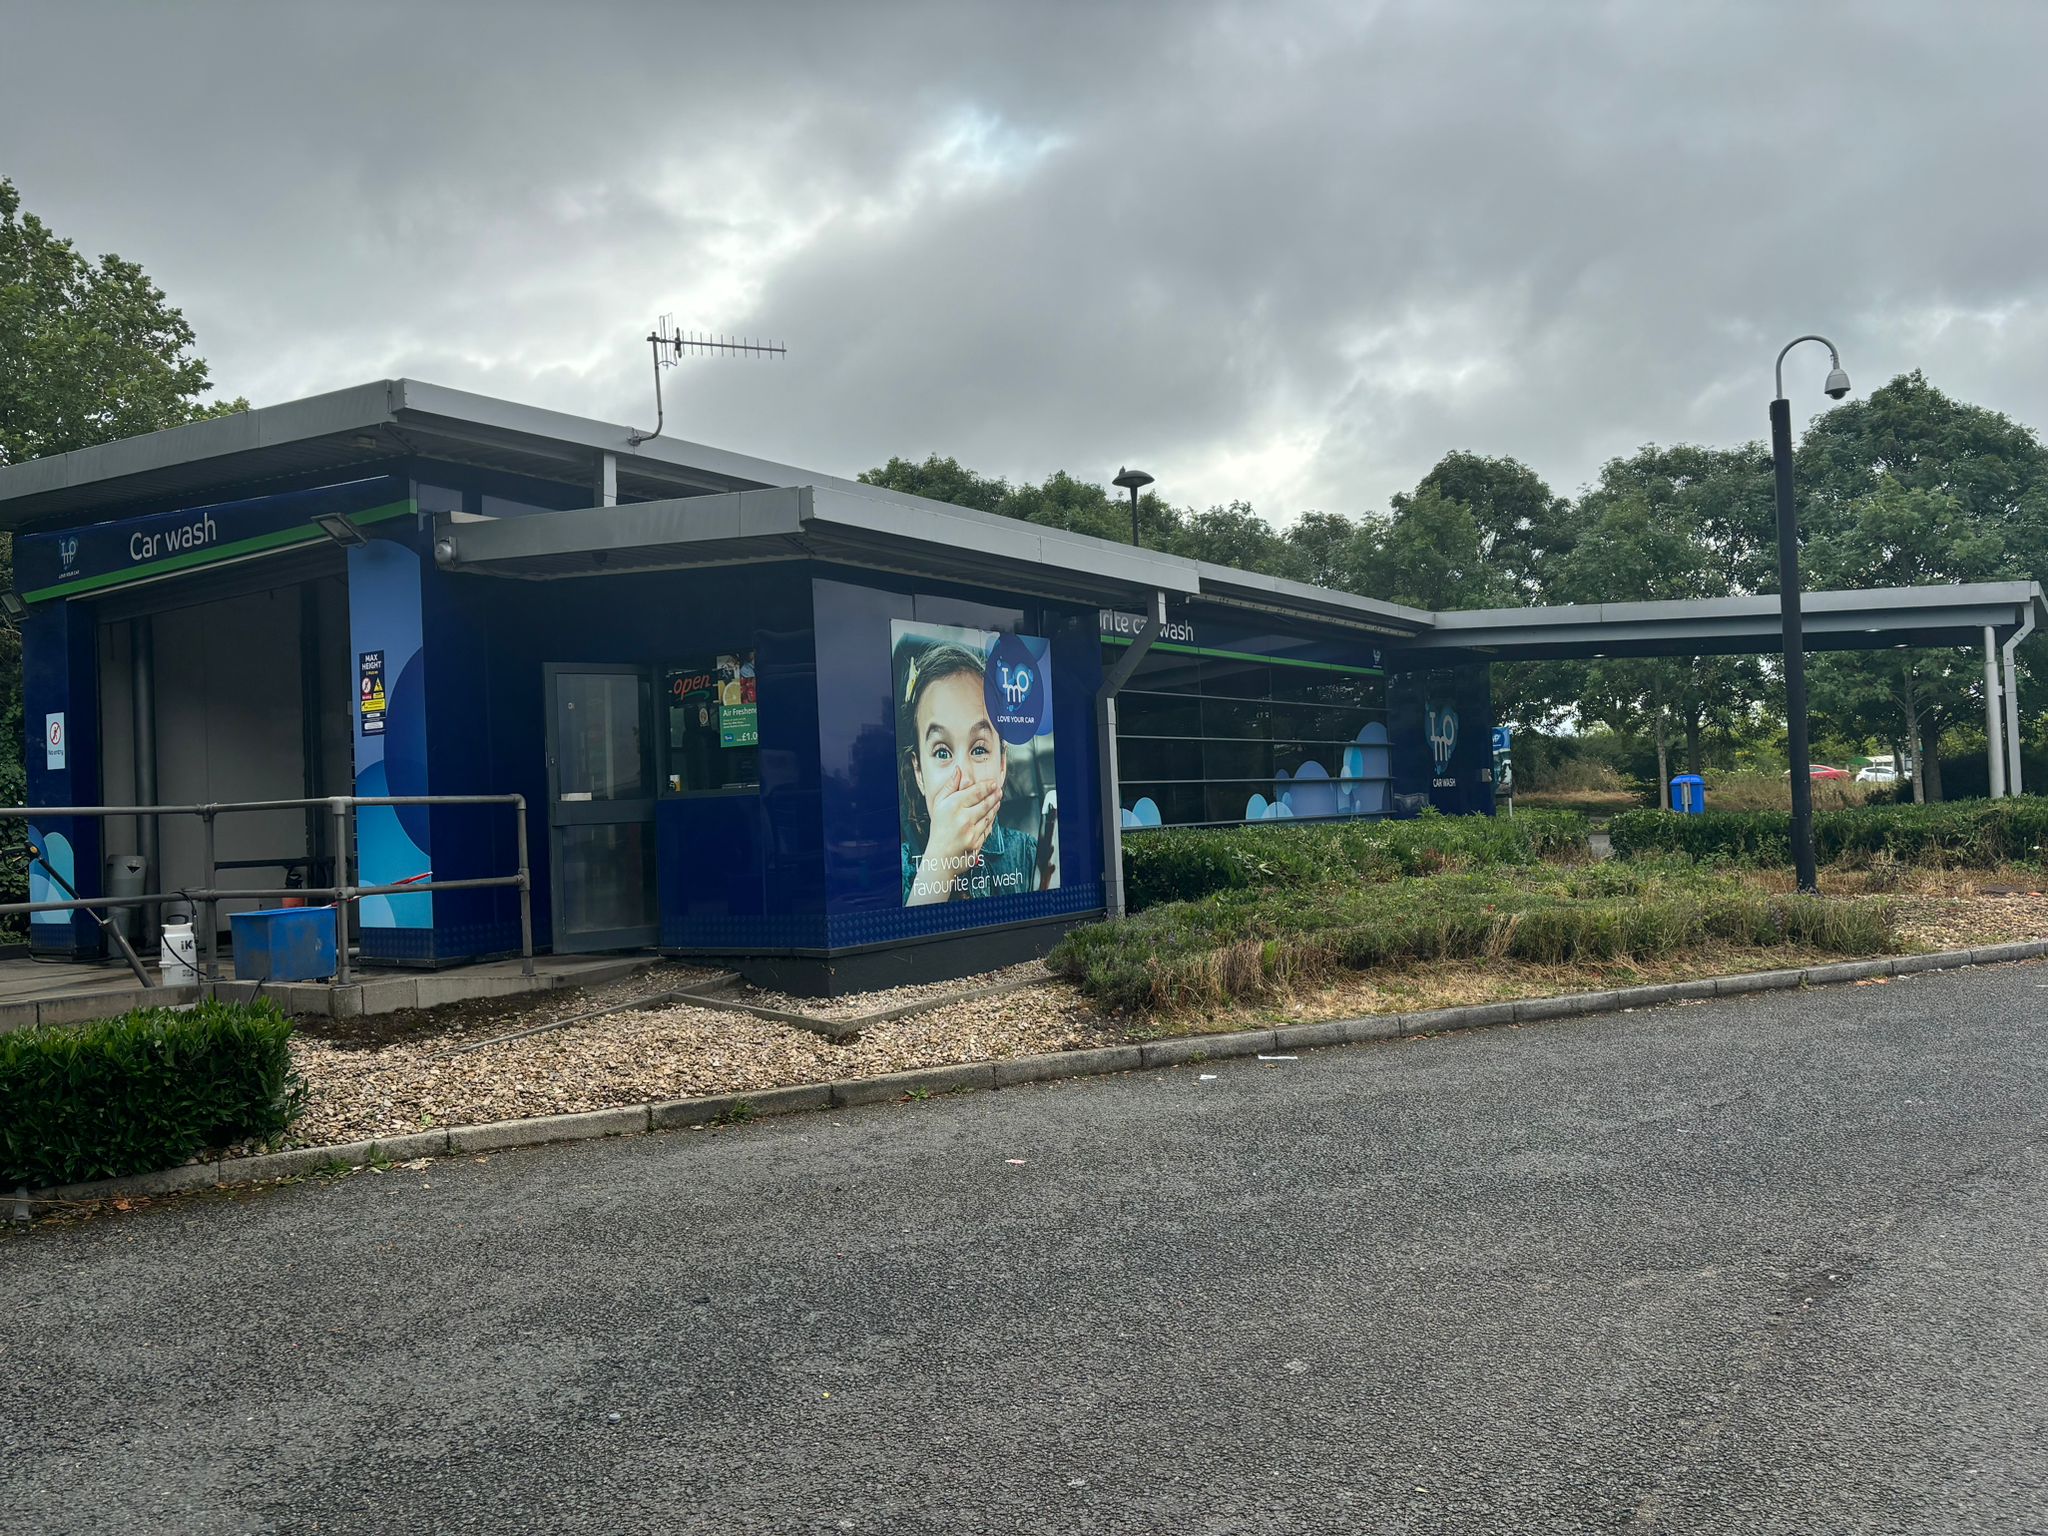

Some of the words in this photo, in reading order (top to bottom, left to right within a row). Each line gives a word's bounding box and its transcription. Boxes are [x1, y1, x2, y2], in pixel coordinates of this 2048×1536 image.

[130, 532, 160, 561] Car
[165, 512, 217, 552] wash
[1160, 620, 1194, 642] wash
[361, 660, 382, 670] HEIGHT
[365, 653, 378, 662] MAX
[674, 674, 711, 700] open
[997, 715, 1010, 723] LOVE
[1025, 716, 1034, 724] CAR
[1433, 778, 1443, 787] CAR
[1443, 778, 1456, 787] WASH
[912, 855, 937, 873] The
[941, 849, 985, 870] world's
[913, 874, 969, 896] favourite
[971, 874, 990, 890] car
[992, 867, 1023, 888] wash
